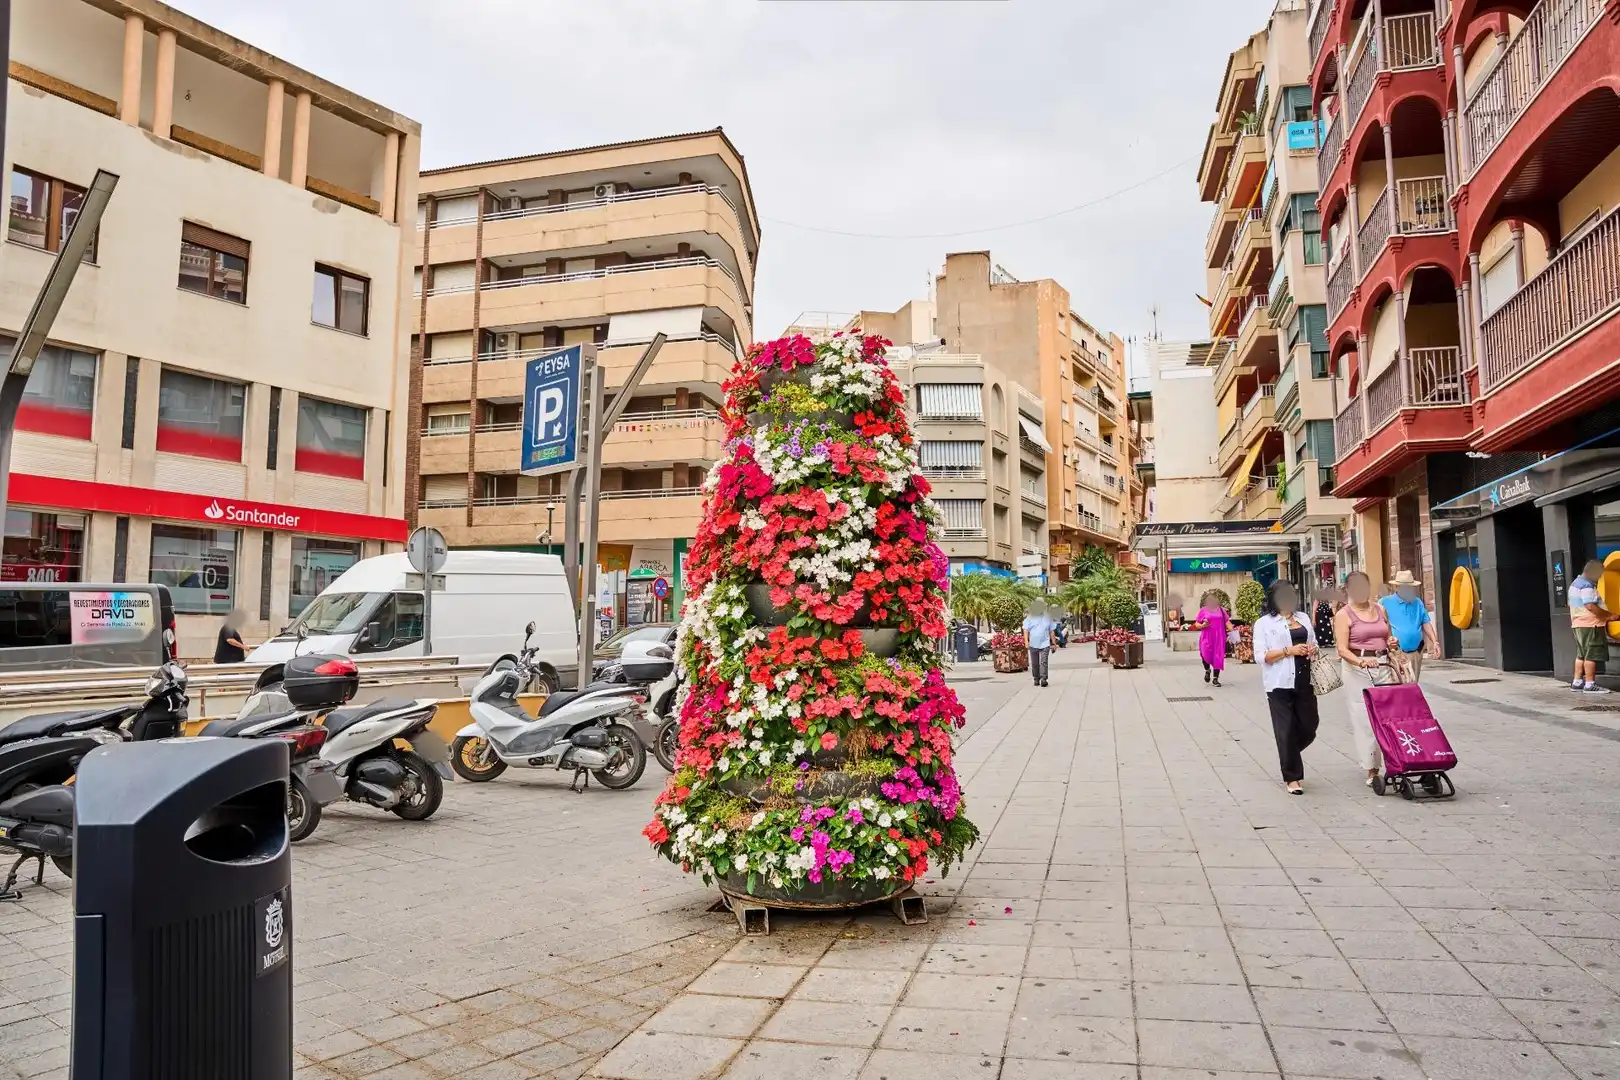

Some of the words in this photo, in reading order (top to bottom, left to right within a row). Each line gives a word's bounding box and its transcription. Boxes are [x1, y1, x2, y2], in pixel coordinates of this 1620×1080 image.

[544, 354, 570, 375] EYSA
[537, 387, 564, 441] P
[1500, 475, 1531, 500] CaixaBank
[226, 505, 300, 527] Santander
[1201, 561, 1228, 570] Unicaja
[91, 608, 135, 619] DAVID
